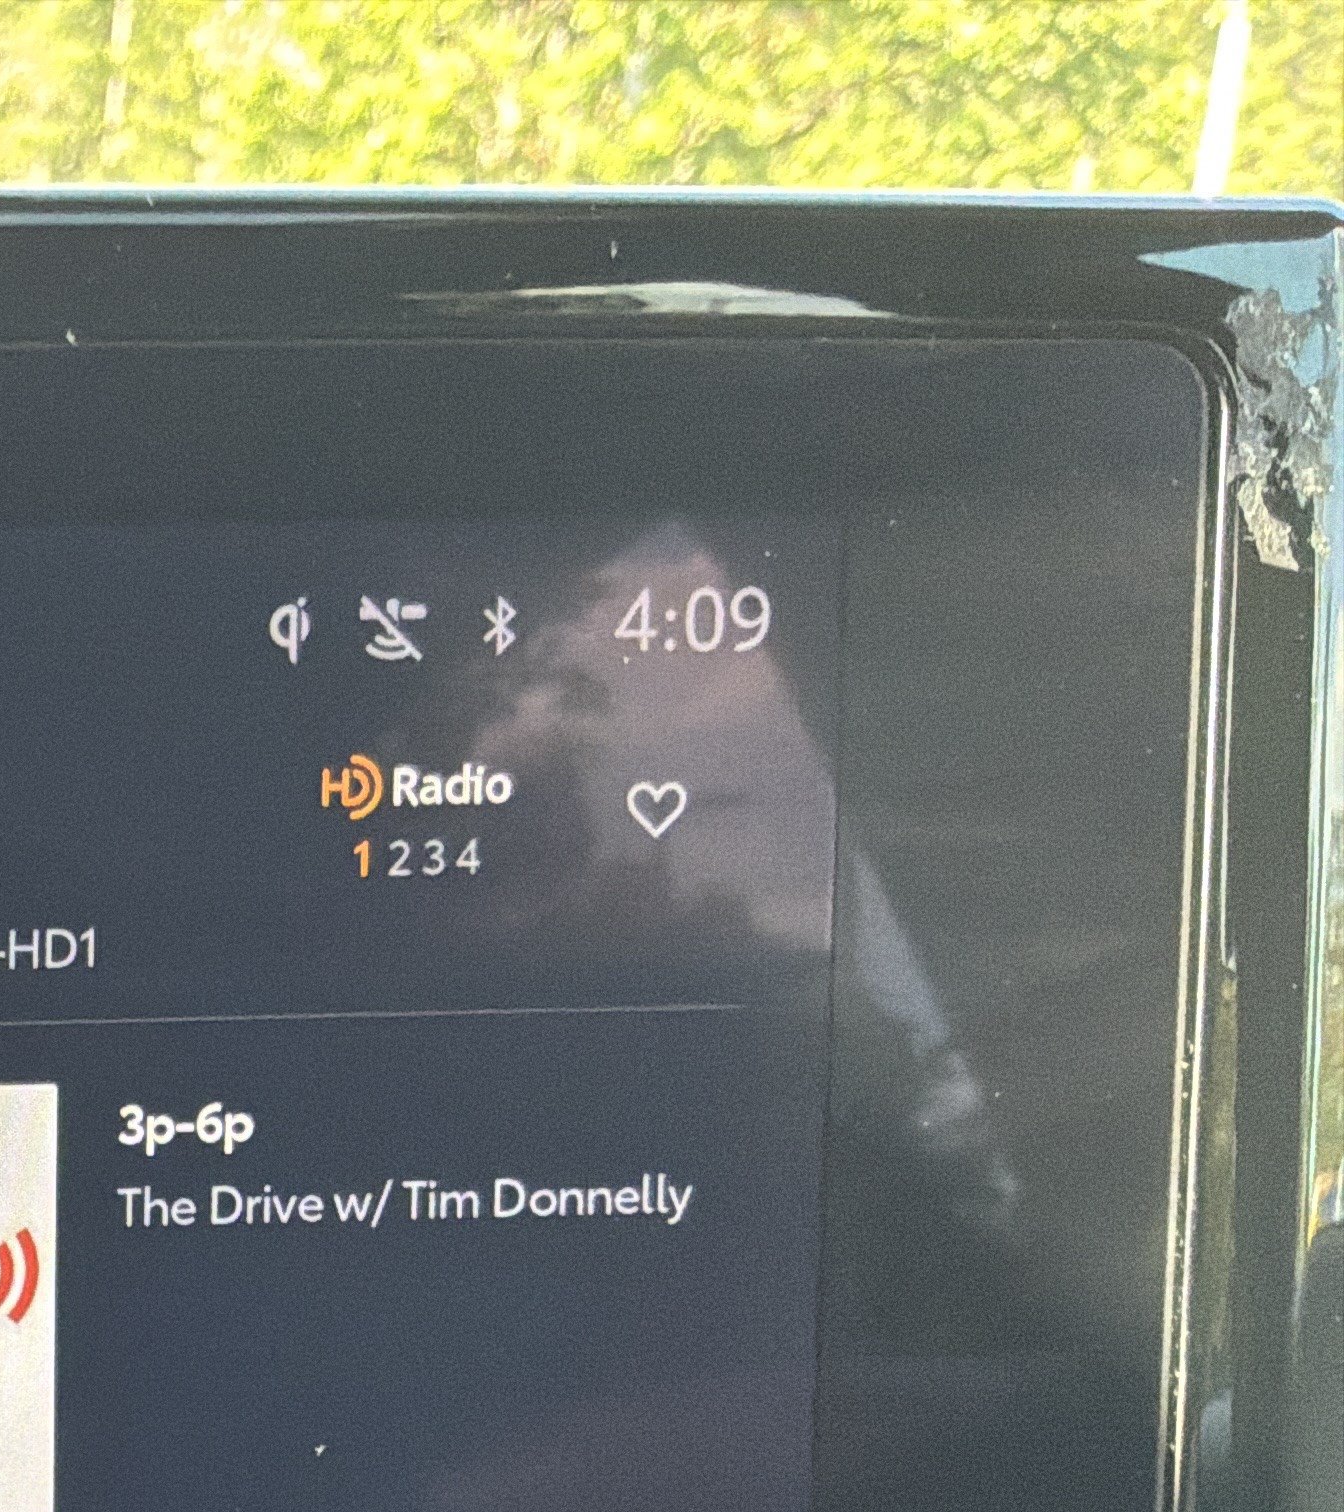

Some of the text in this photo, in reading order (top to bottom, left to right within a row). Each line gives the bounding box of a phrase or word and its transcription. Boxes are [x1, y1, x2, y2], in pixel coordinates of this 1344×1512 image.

[612, 584, 772, 654] 4:09
[391, 761, 514, 808] Radio
[117, 1100, 256, 1158] 3p-6p
[116, 1172, 694, 1230] The Drive w/ Tim Donnelly
